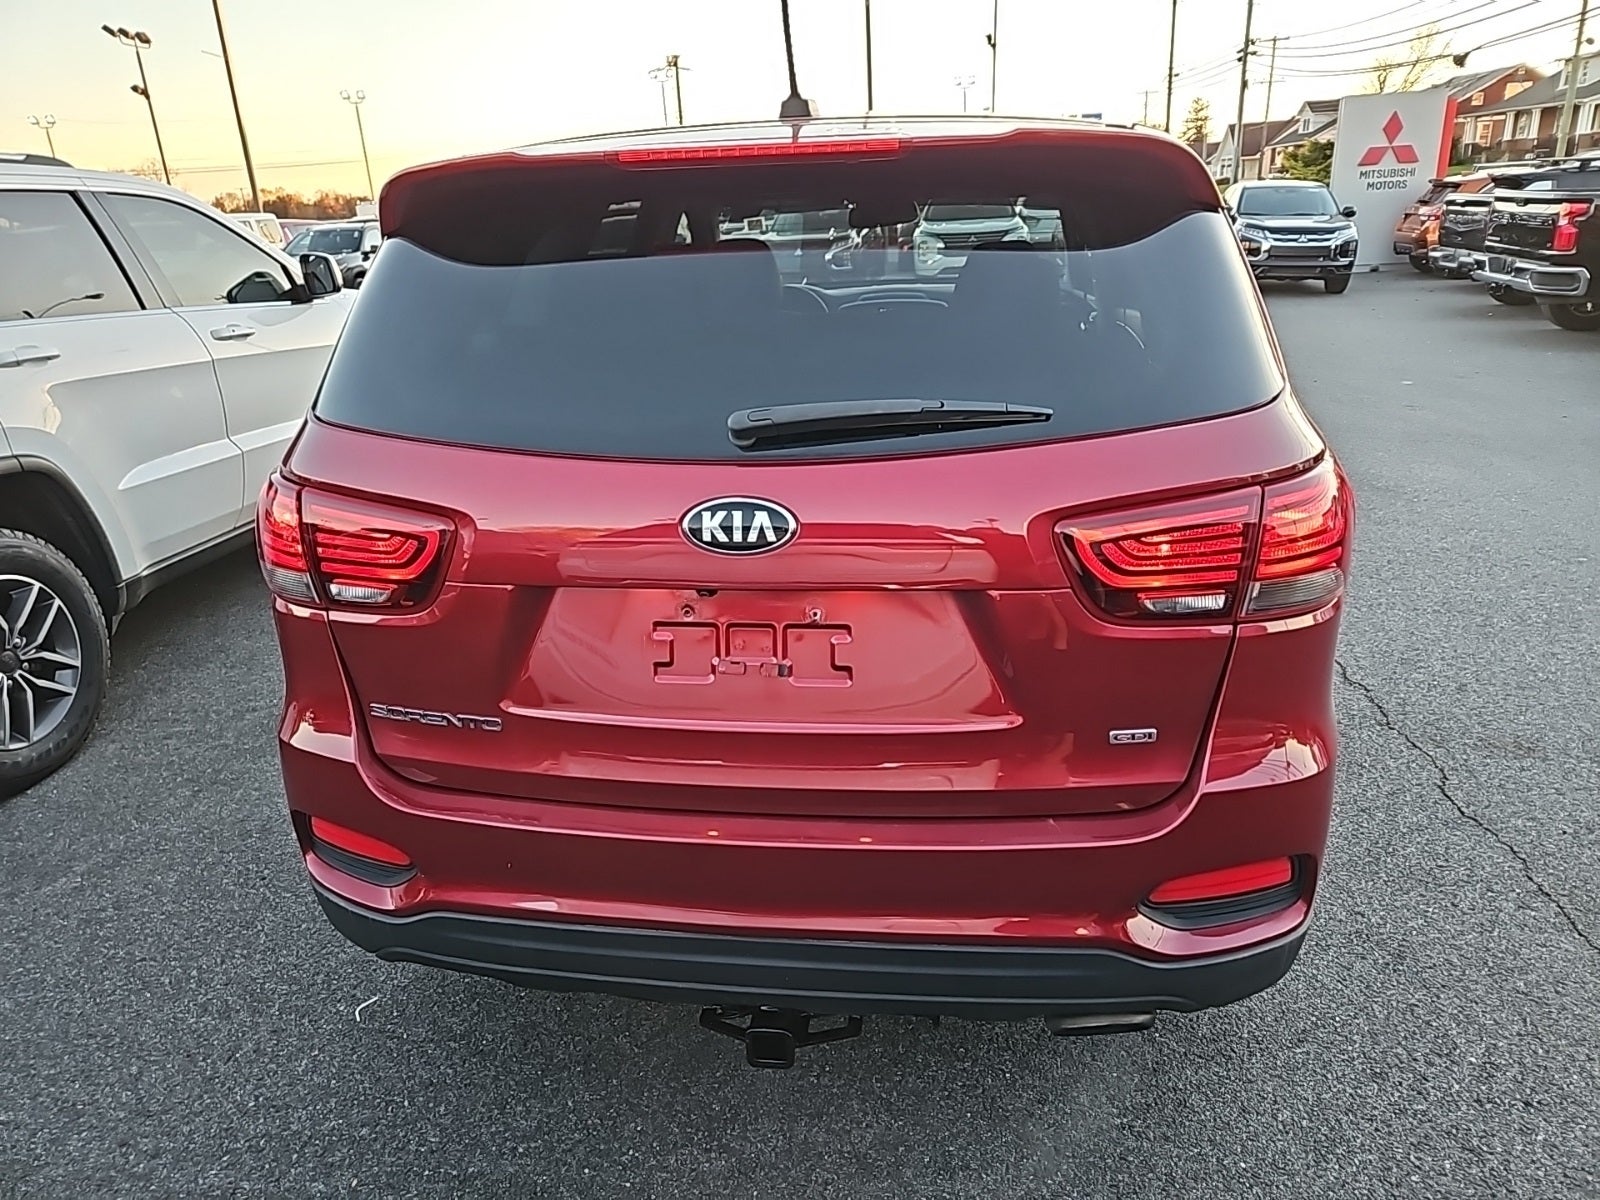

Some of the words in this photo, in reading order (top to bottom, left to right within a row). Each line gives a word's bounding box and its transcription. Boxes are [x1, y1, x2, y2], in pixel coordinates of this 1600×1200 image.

[1359, 167, 1416, 180] MITSUBISHI
[1366, 180, 1408, 191] MOTORS
[701, 510, 777, 542] KIA
[369, 703, 502, 731] SORENTO
[1111, 731, 1156, 743] GDI
